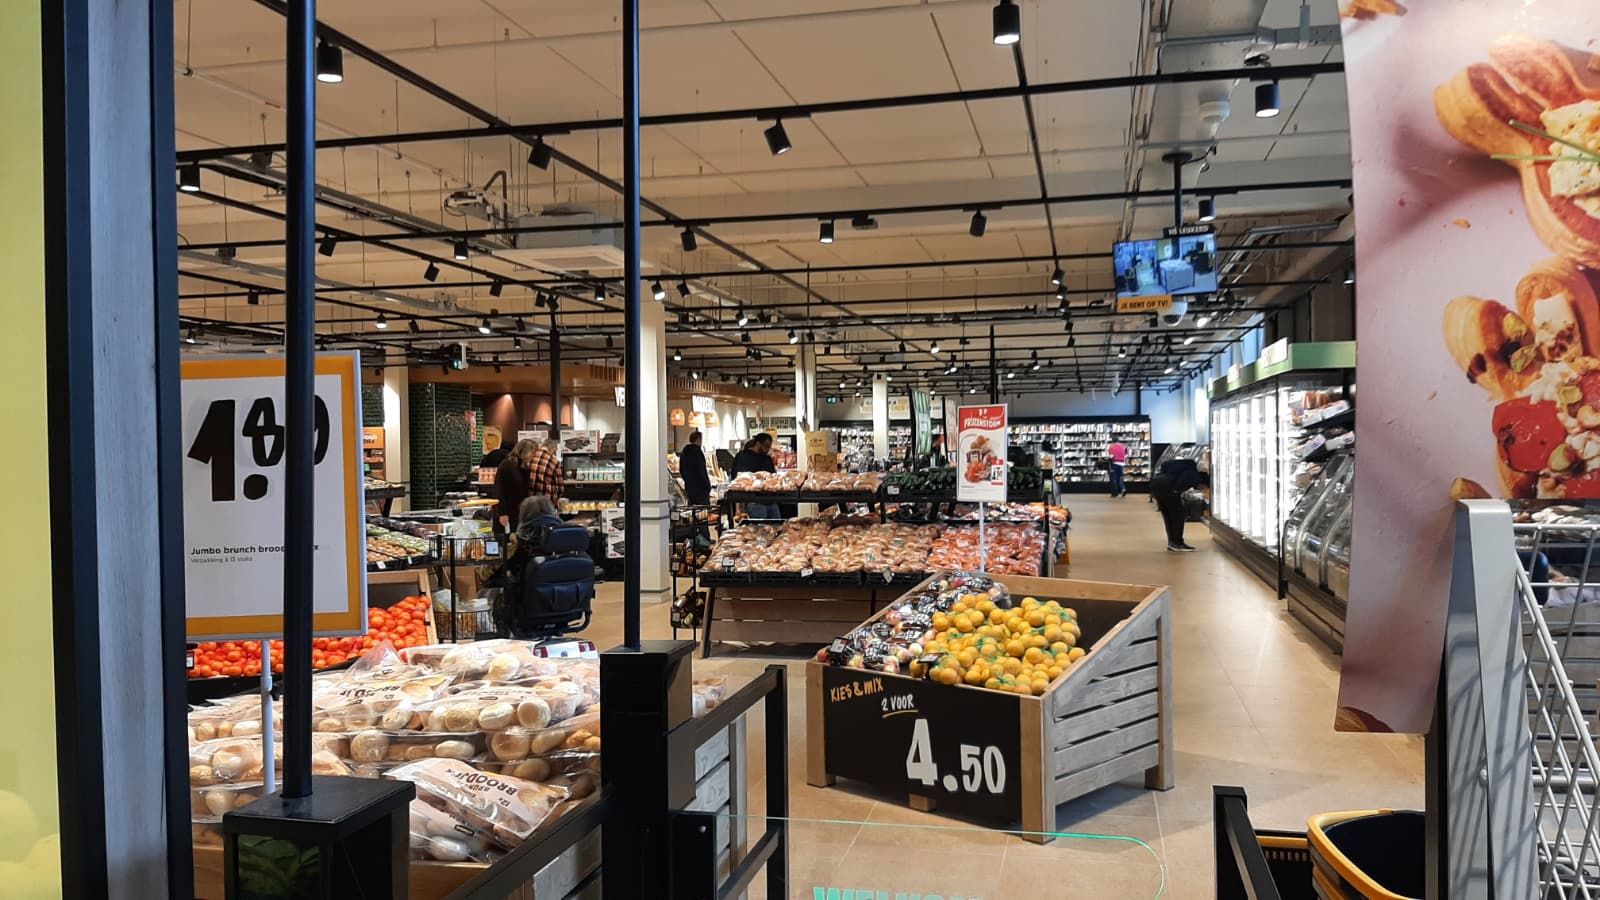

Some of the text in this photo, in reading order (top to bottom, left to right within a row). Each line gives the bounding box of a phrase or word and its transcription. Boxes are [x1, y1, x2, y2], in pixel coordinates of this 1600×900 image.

[1121, 302, 1128, 310] JE
[1129, 301, 1145, 309] BENT
[1157, 299, 1168, 307] TV!
[191, 547, 221, 555] Jumbo
[223, 545, 256, 554] brunch
[830, 684, 852, 702] KIES
[881, 694, 914, 711] 2 VOOR
[905, 718, 1006, 794] 4.50
